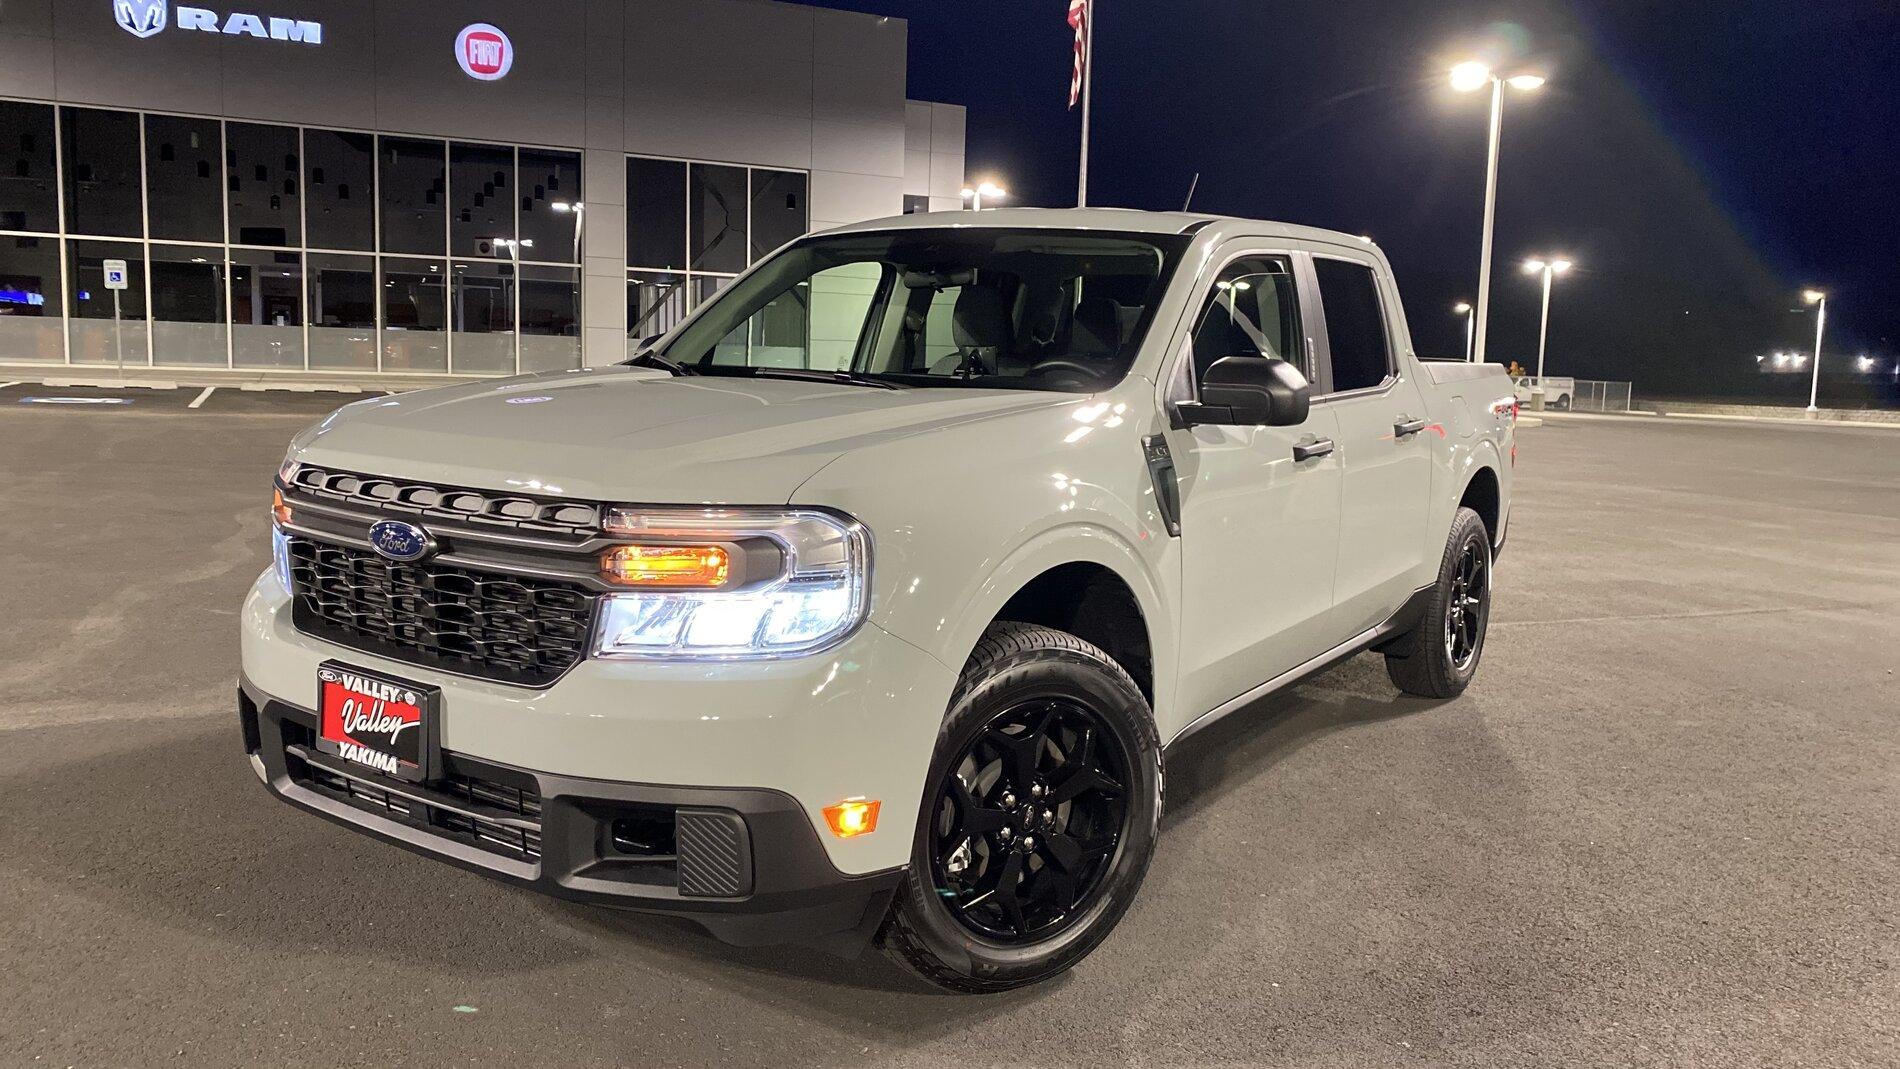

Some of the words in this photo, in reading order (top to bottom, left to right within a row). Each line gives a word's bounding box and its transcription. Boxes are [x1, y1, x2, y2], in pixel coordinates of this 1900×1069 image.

[176, 6, 322, 44] RAM
[469, 38, 502, 67] FIAT
[379, 529, 411, 552] Ford
[342, 673, 400, 703] VALLEY
[341, 697, 420, 746] Valley
[339, 741, 398, 774] YAKIMA
